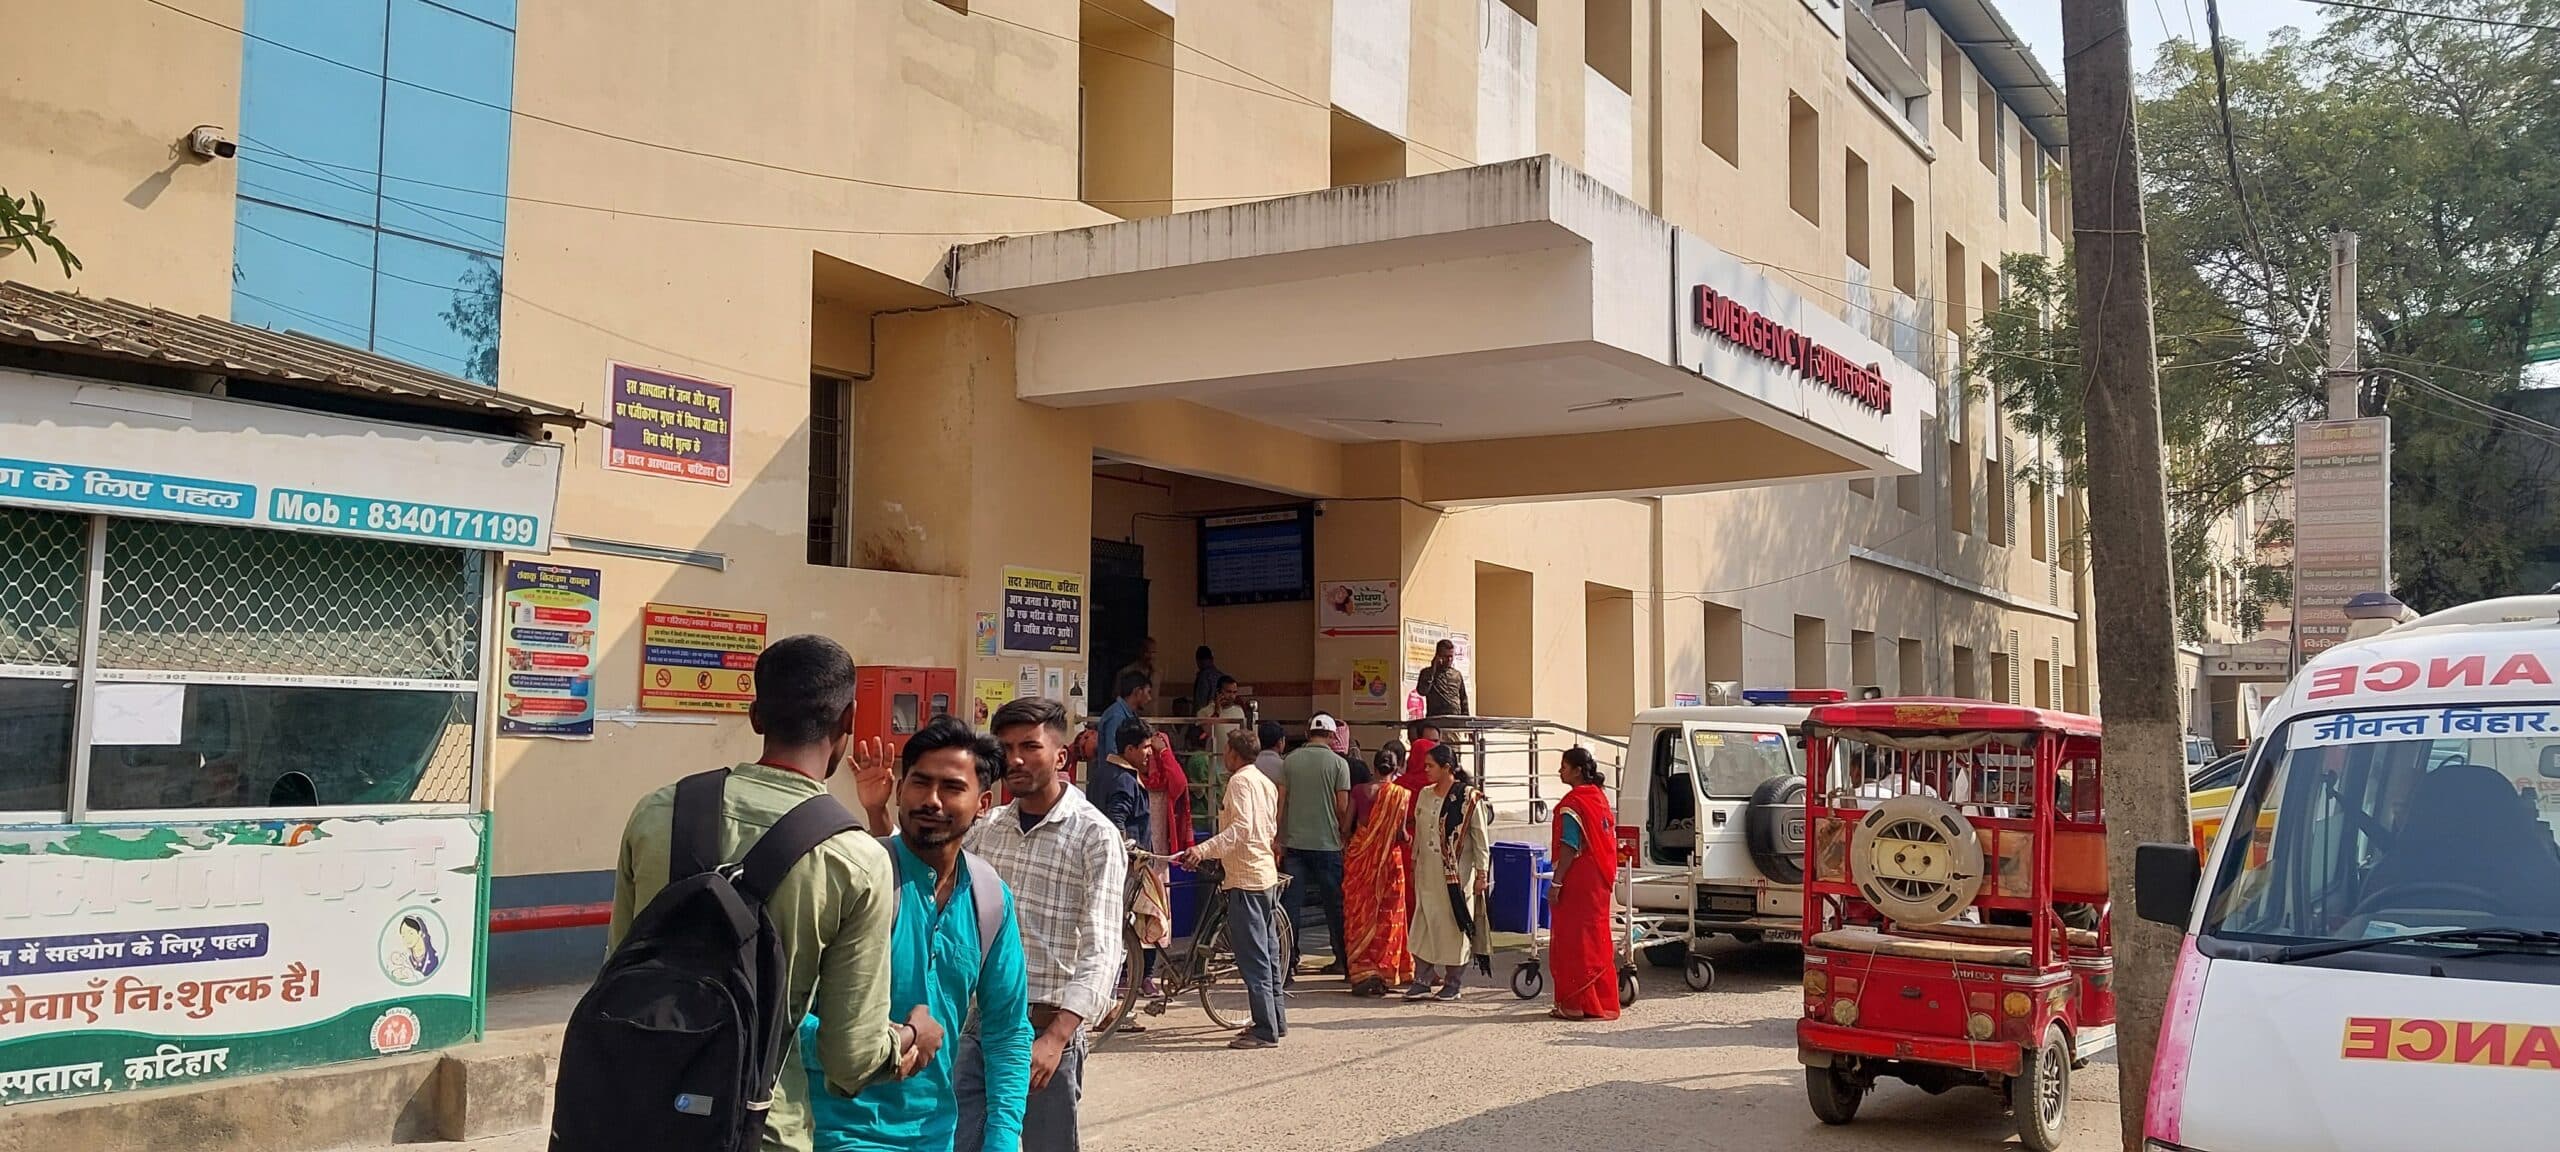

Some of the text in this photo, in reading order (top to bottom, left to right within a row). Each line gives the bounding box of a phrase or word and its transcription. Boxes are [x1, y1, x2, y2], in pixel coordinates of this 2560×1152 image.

[1695, 284, 1807, 376] EMERGENCY
[1814, 344, 1892, 415] आपातकालीन
[625, 379, 637, 395] इस
[639, 381, 667, 400] अस्पताल
[668, 384, 676, 400] में
[676, 389, 691, 405] जन्म
[693, 389, 705, 406] और
[616, 402, 626, 416] का
[628, 401, 658, 422] पंजीकरण
[676, 410, 685, 427] में
[684, 411, 700, 430] किया
[702, 417, 718, 433] जाता
[642, 428, 701, 454] बिना कोई शुल्क के
[33, 467, 73, 491] के
[83, 470, 153, 500] लिए
[161, 484, 243, 509] पहल
[276, 492, 340, 525] Mob
[367, 502, 533, 544] 8340171199
[1008, 576, 1022, 587] सदर
[1057, 580, 1079, 593] कटिहार
[1006, 607, 1016, 618] कि
[1017, 610, 1028, 619] एक
[1009, 595, 1023, 605] आम
[1024, 596, 1042, 607] जनता
[2313, 713, 2430, 741] जीवन्त
[18, 942, 40, 965] में
[44, 938, 125, 962] सहयोग
[131, 935, 154, 958] के
[160, 933, 205, 959] लिए
[211, 932, 259, 950] पहल
[124, 1044, 230, 1081] कटिहार
